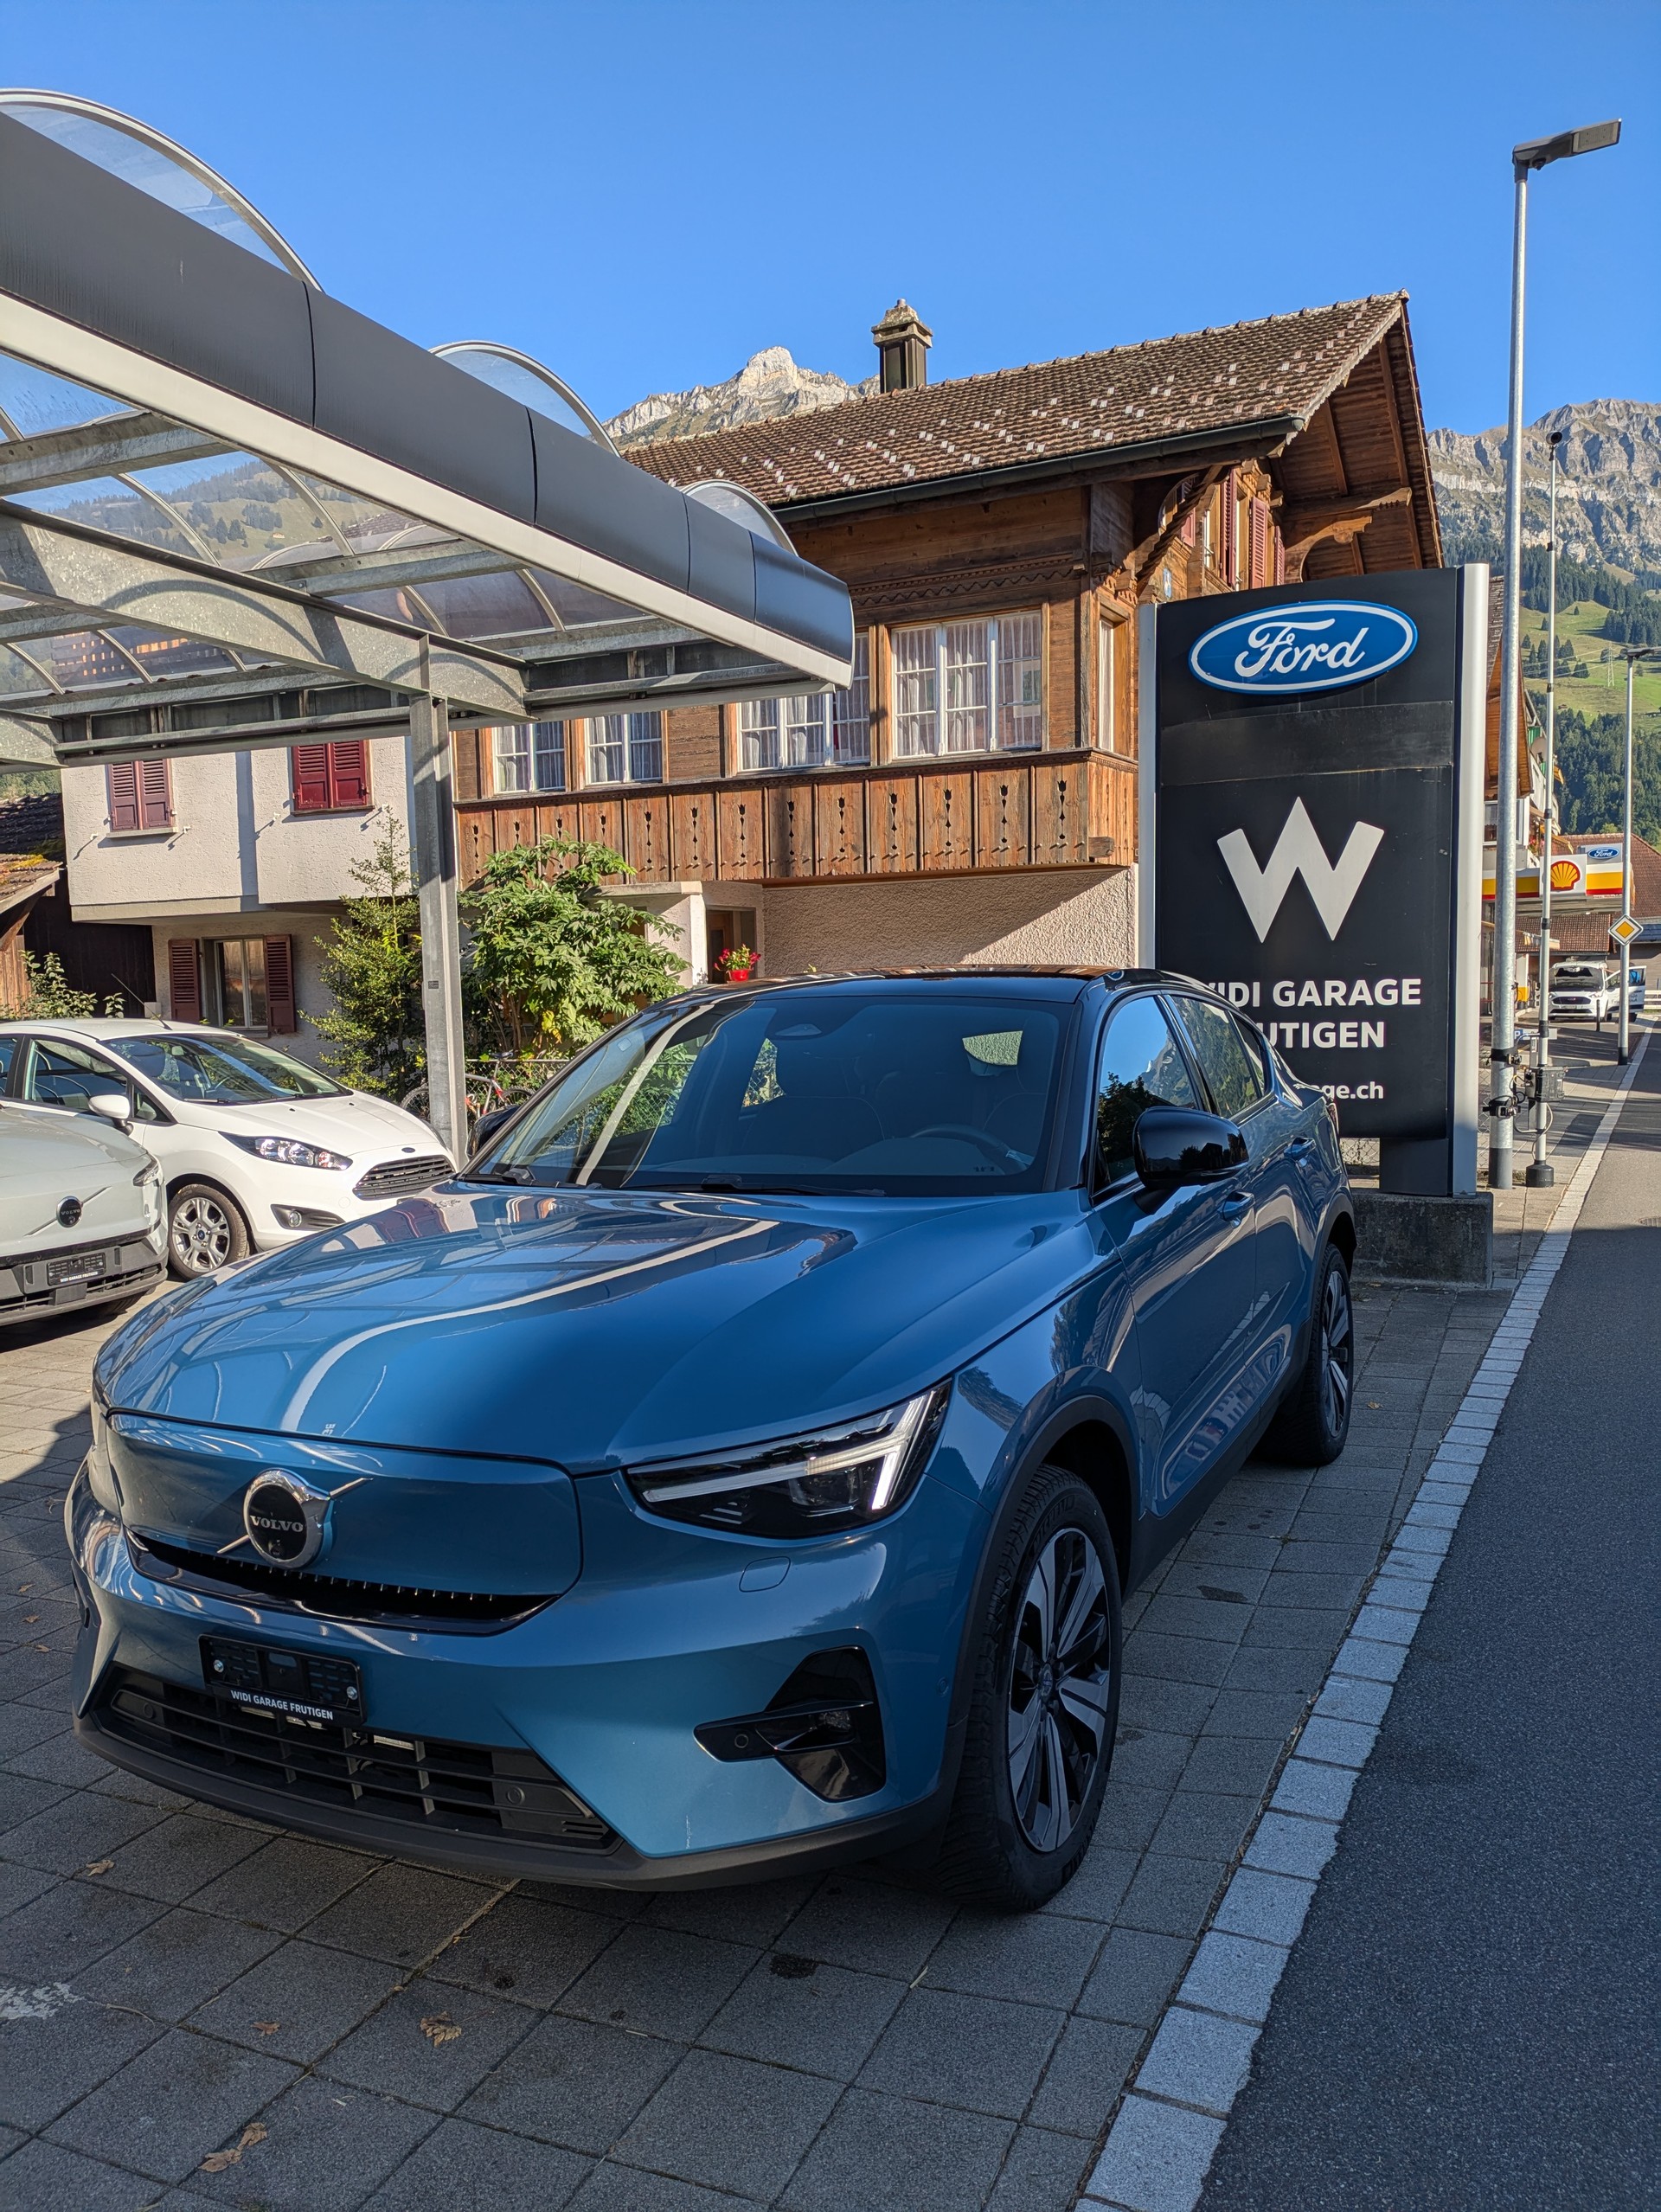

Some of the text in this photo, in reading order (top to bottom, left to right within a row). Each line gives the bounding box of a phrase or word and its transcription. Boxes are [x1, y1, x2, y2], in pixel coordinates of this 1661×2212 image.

[1234, 618, 1369, 677] Ford
[1594, 849, 1613, 857] Ford
[1216, 796, 1385, 944] W
[1273, 978, 1421, 1007] GARAGE
[1514, 1030, 1521, 1040] P
[249, 1515, 304, 1532] VOLVO
[230, 1689, 333, 1720] WIDI GARAGE FRUTIGEN
